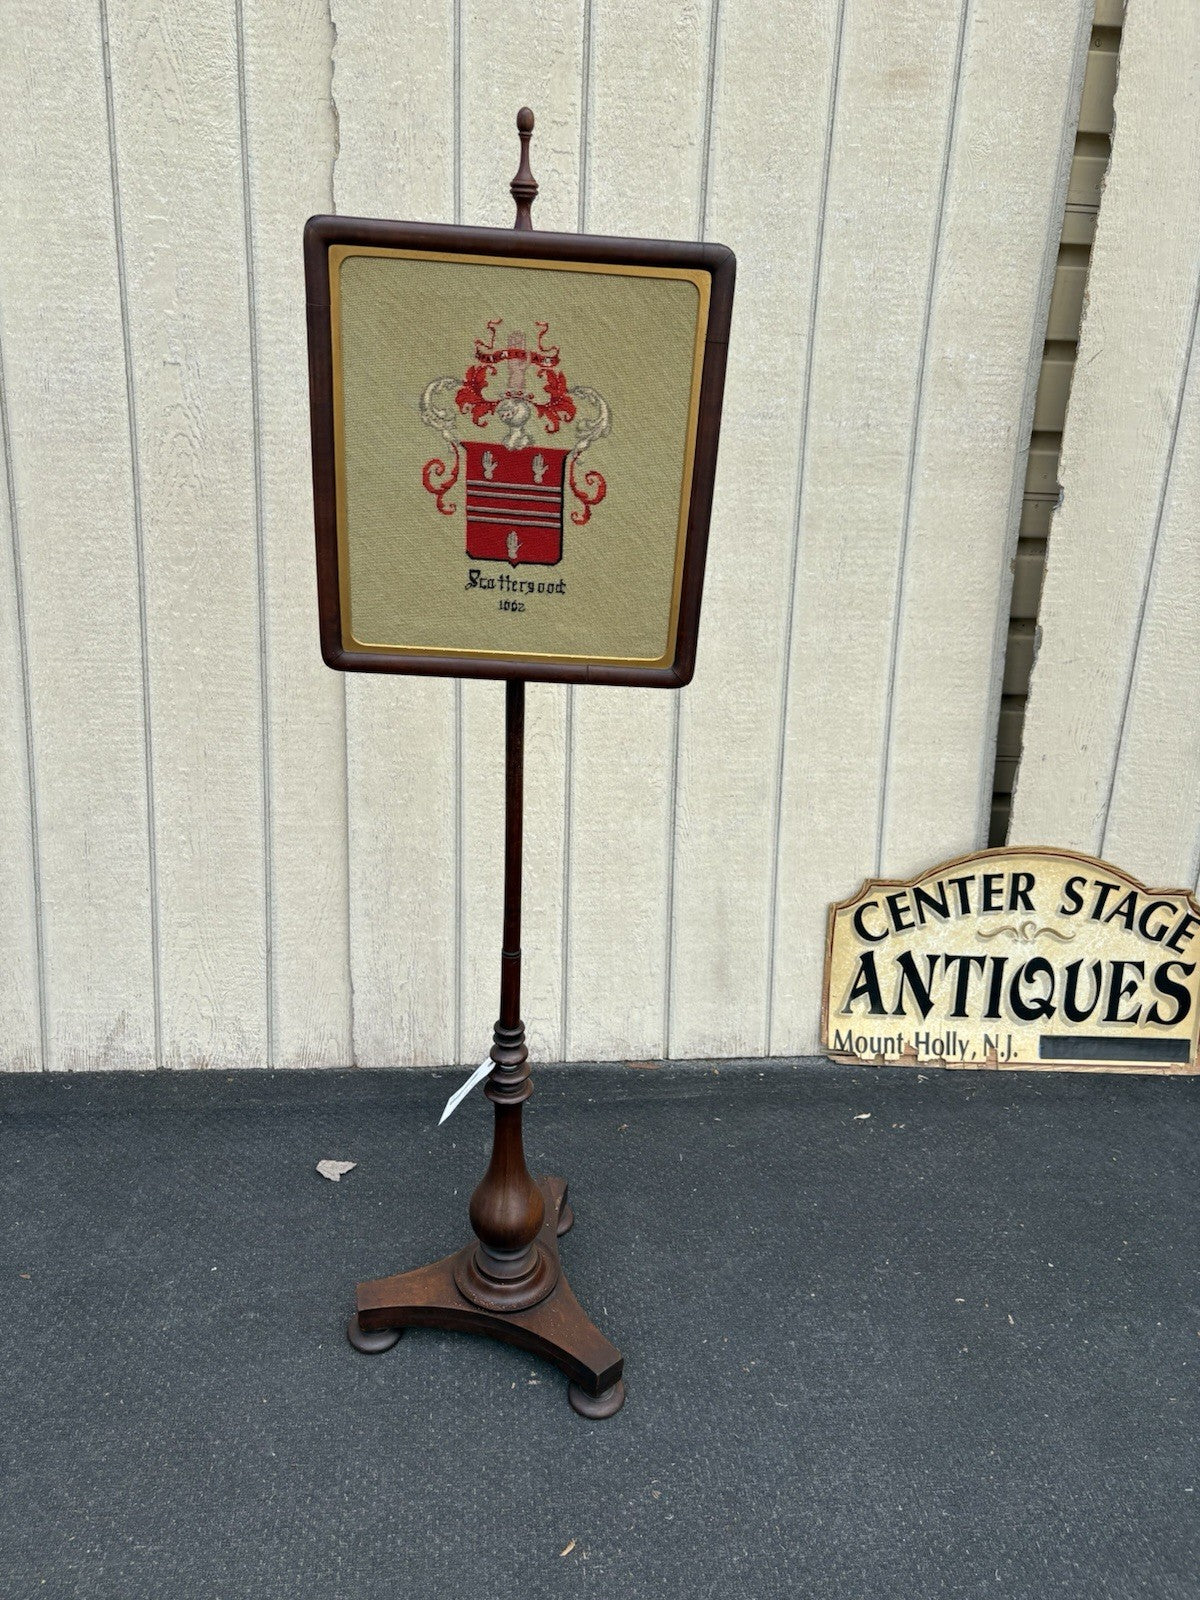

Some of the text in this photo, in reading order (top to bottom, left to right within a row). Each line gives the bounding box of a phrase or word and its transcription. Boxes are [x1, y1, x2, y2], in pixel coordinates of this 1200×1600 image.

[853, 872, 1200, 954] CENTER STAGE
[841, 950, 1197, 1026] ANTIQUES
[834, 1029, 1018, 1062] Mount Holly, N.J.
